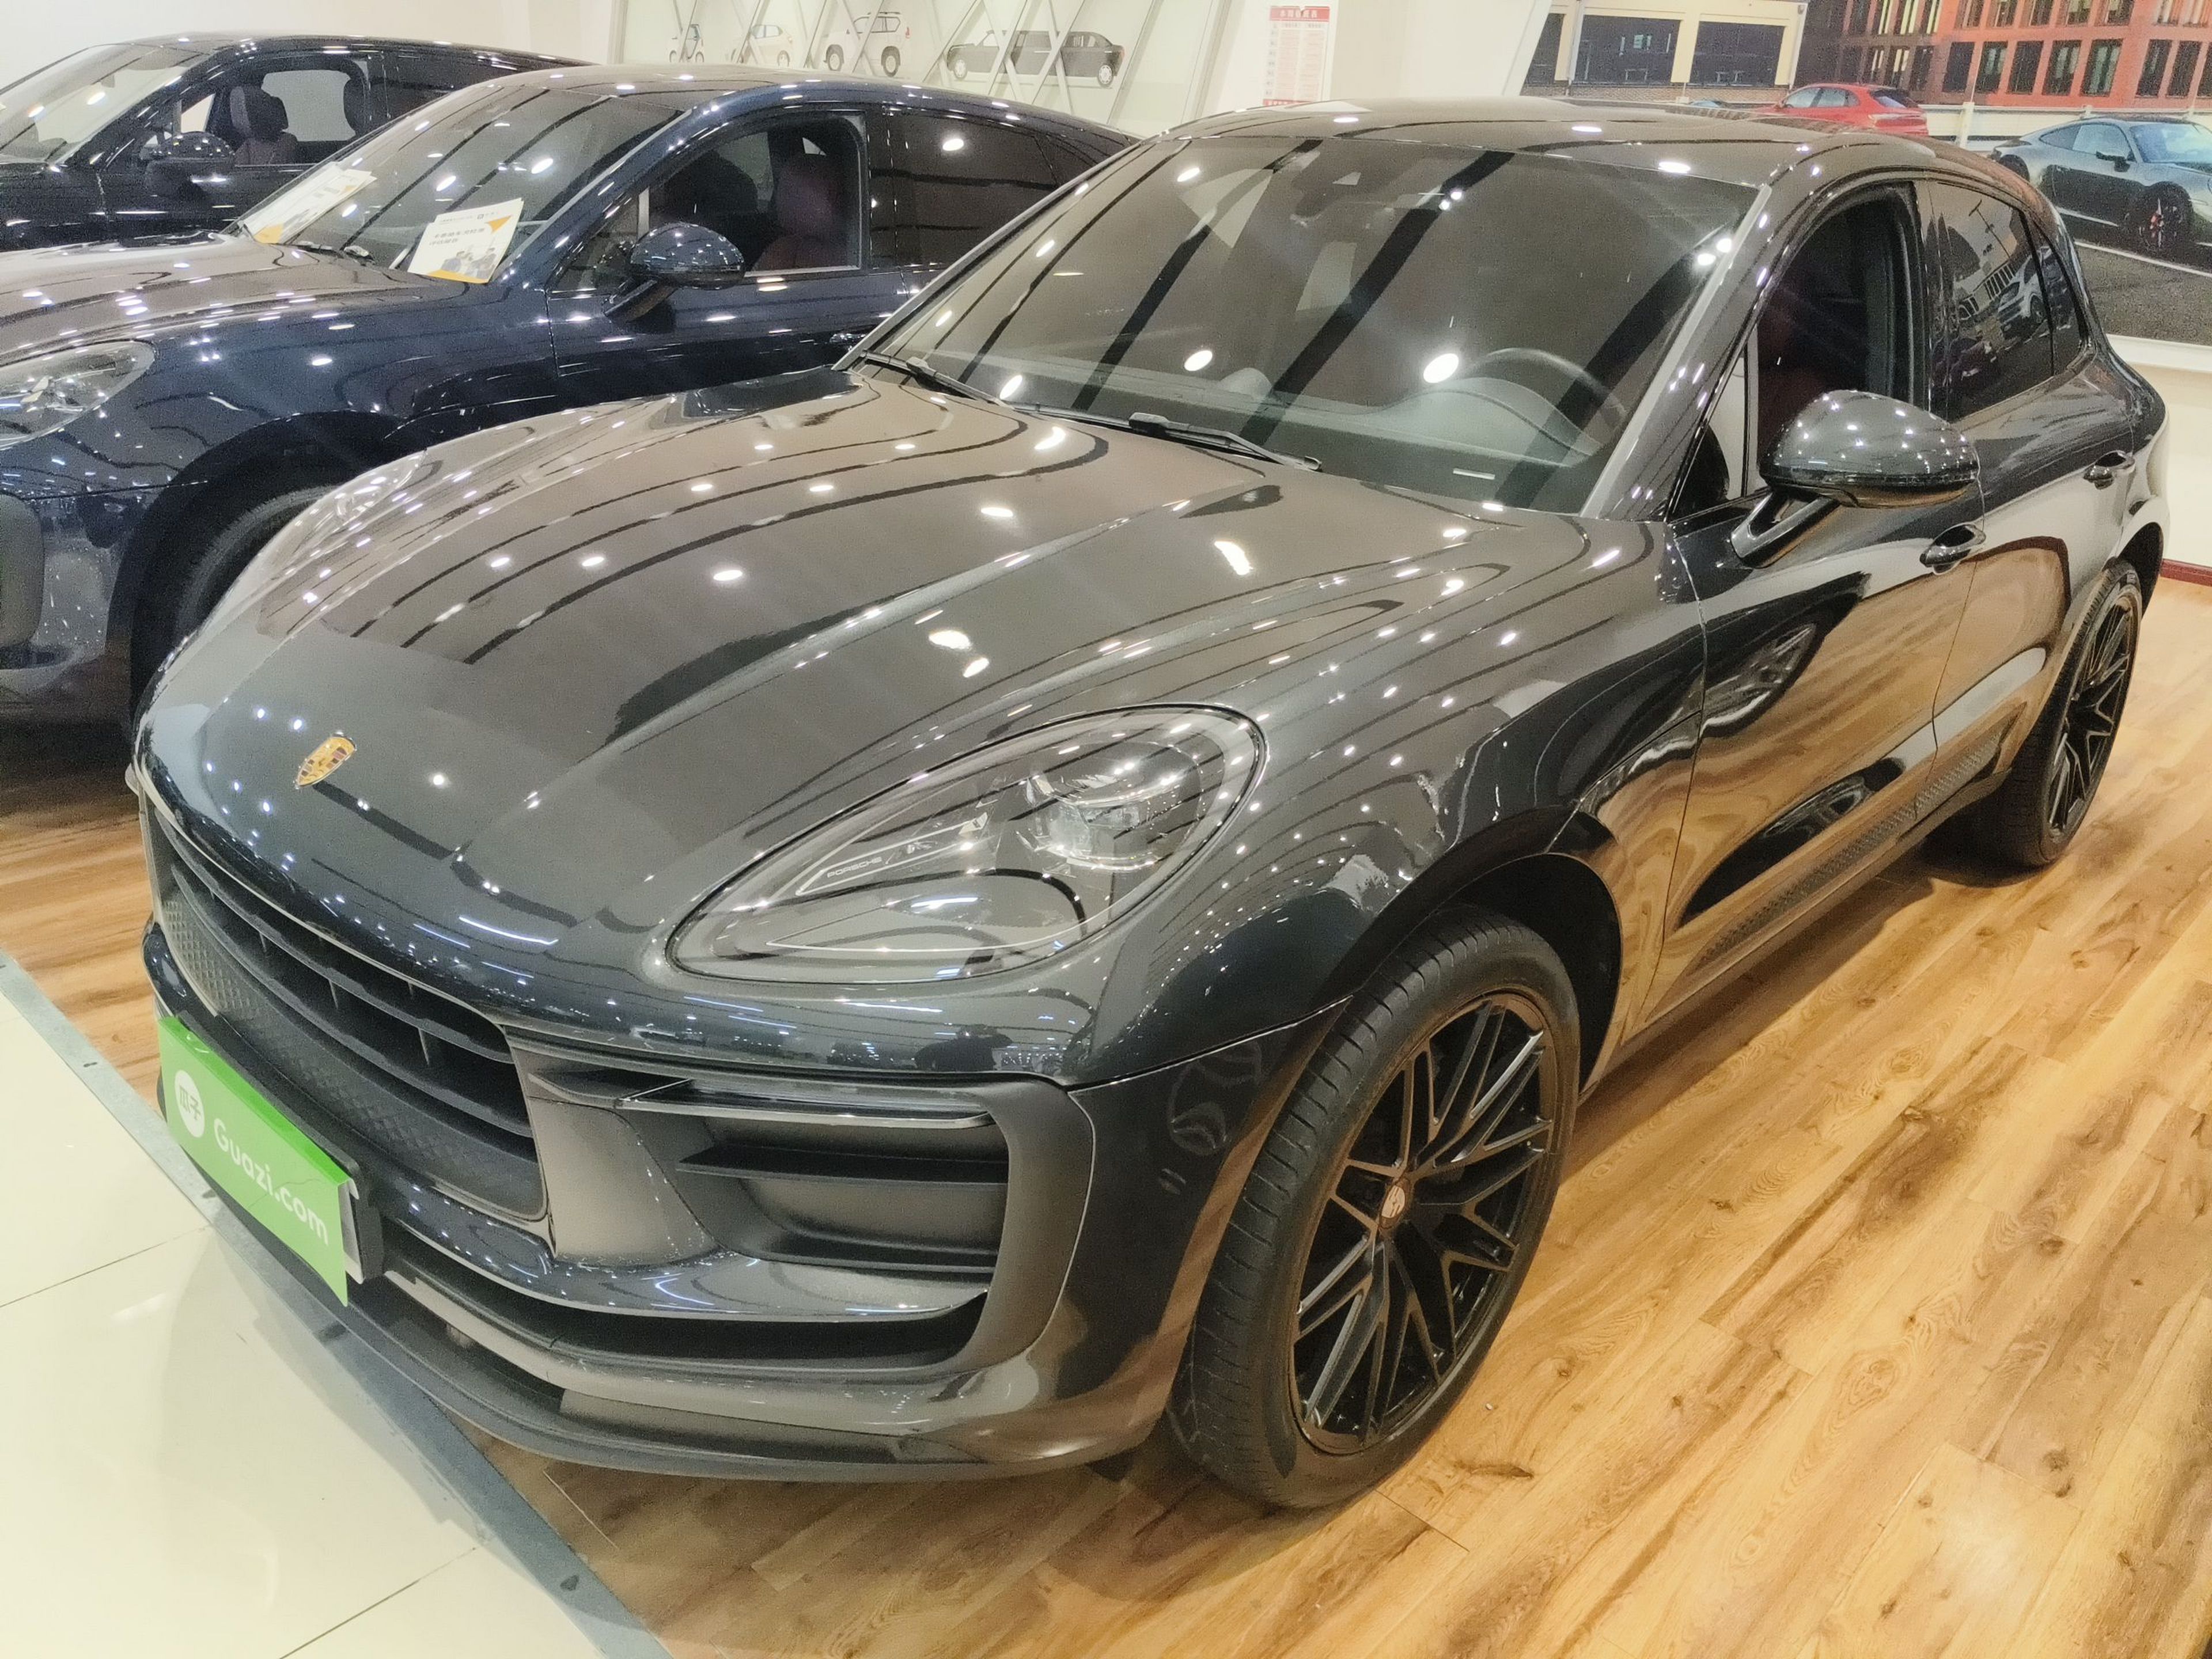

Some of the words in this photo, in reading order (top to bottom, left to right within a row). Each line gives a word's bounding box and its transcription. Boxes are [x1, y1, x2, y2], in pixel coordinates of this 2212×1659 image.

[827, 857, 882, 878] PORSCHE
[179, 1084, 202, 1121] 瓜子
[213, 1118, 329, 1247] Guazi.com
